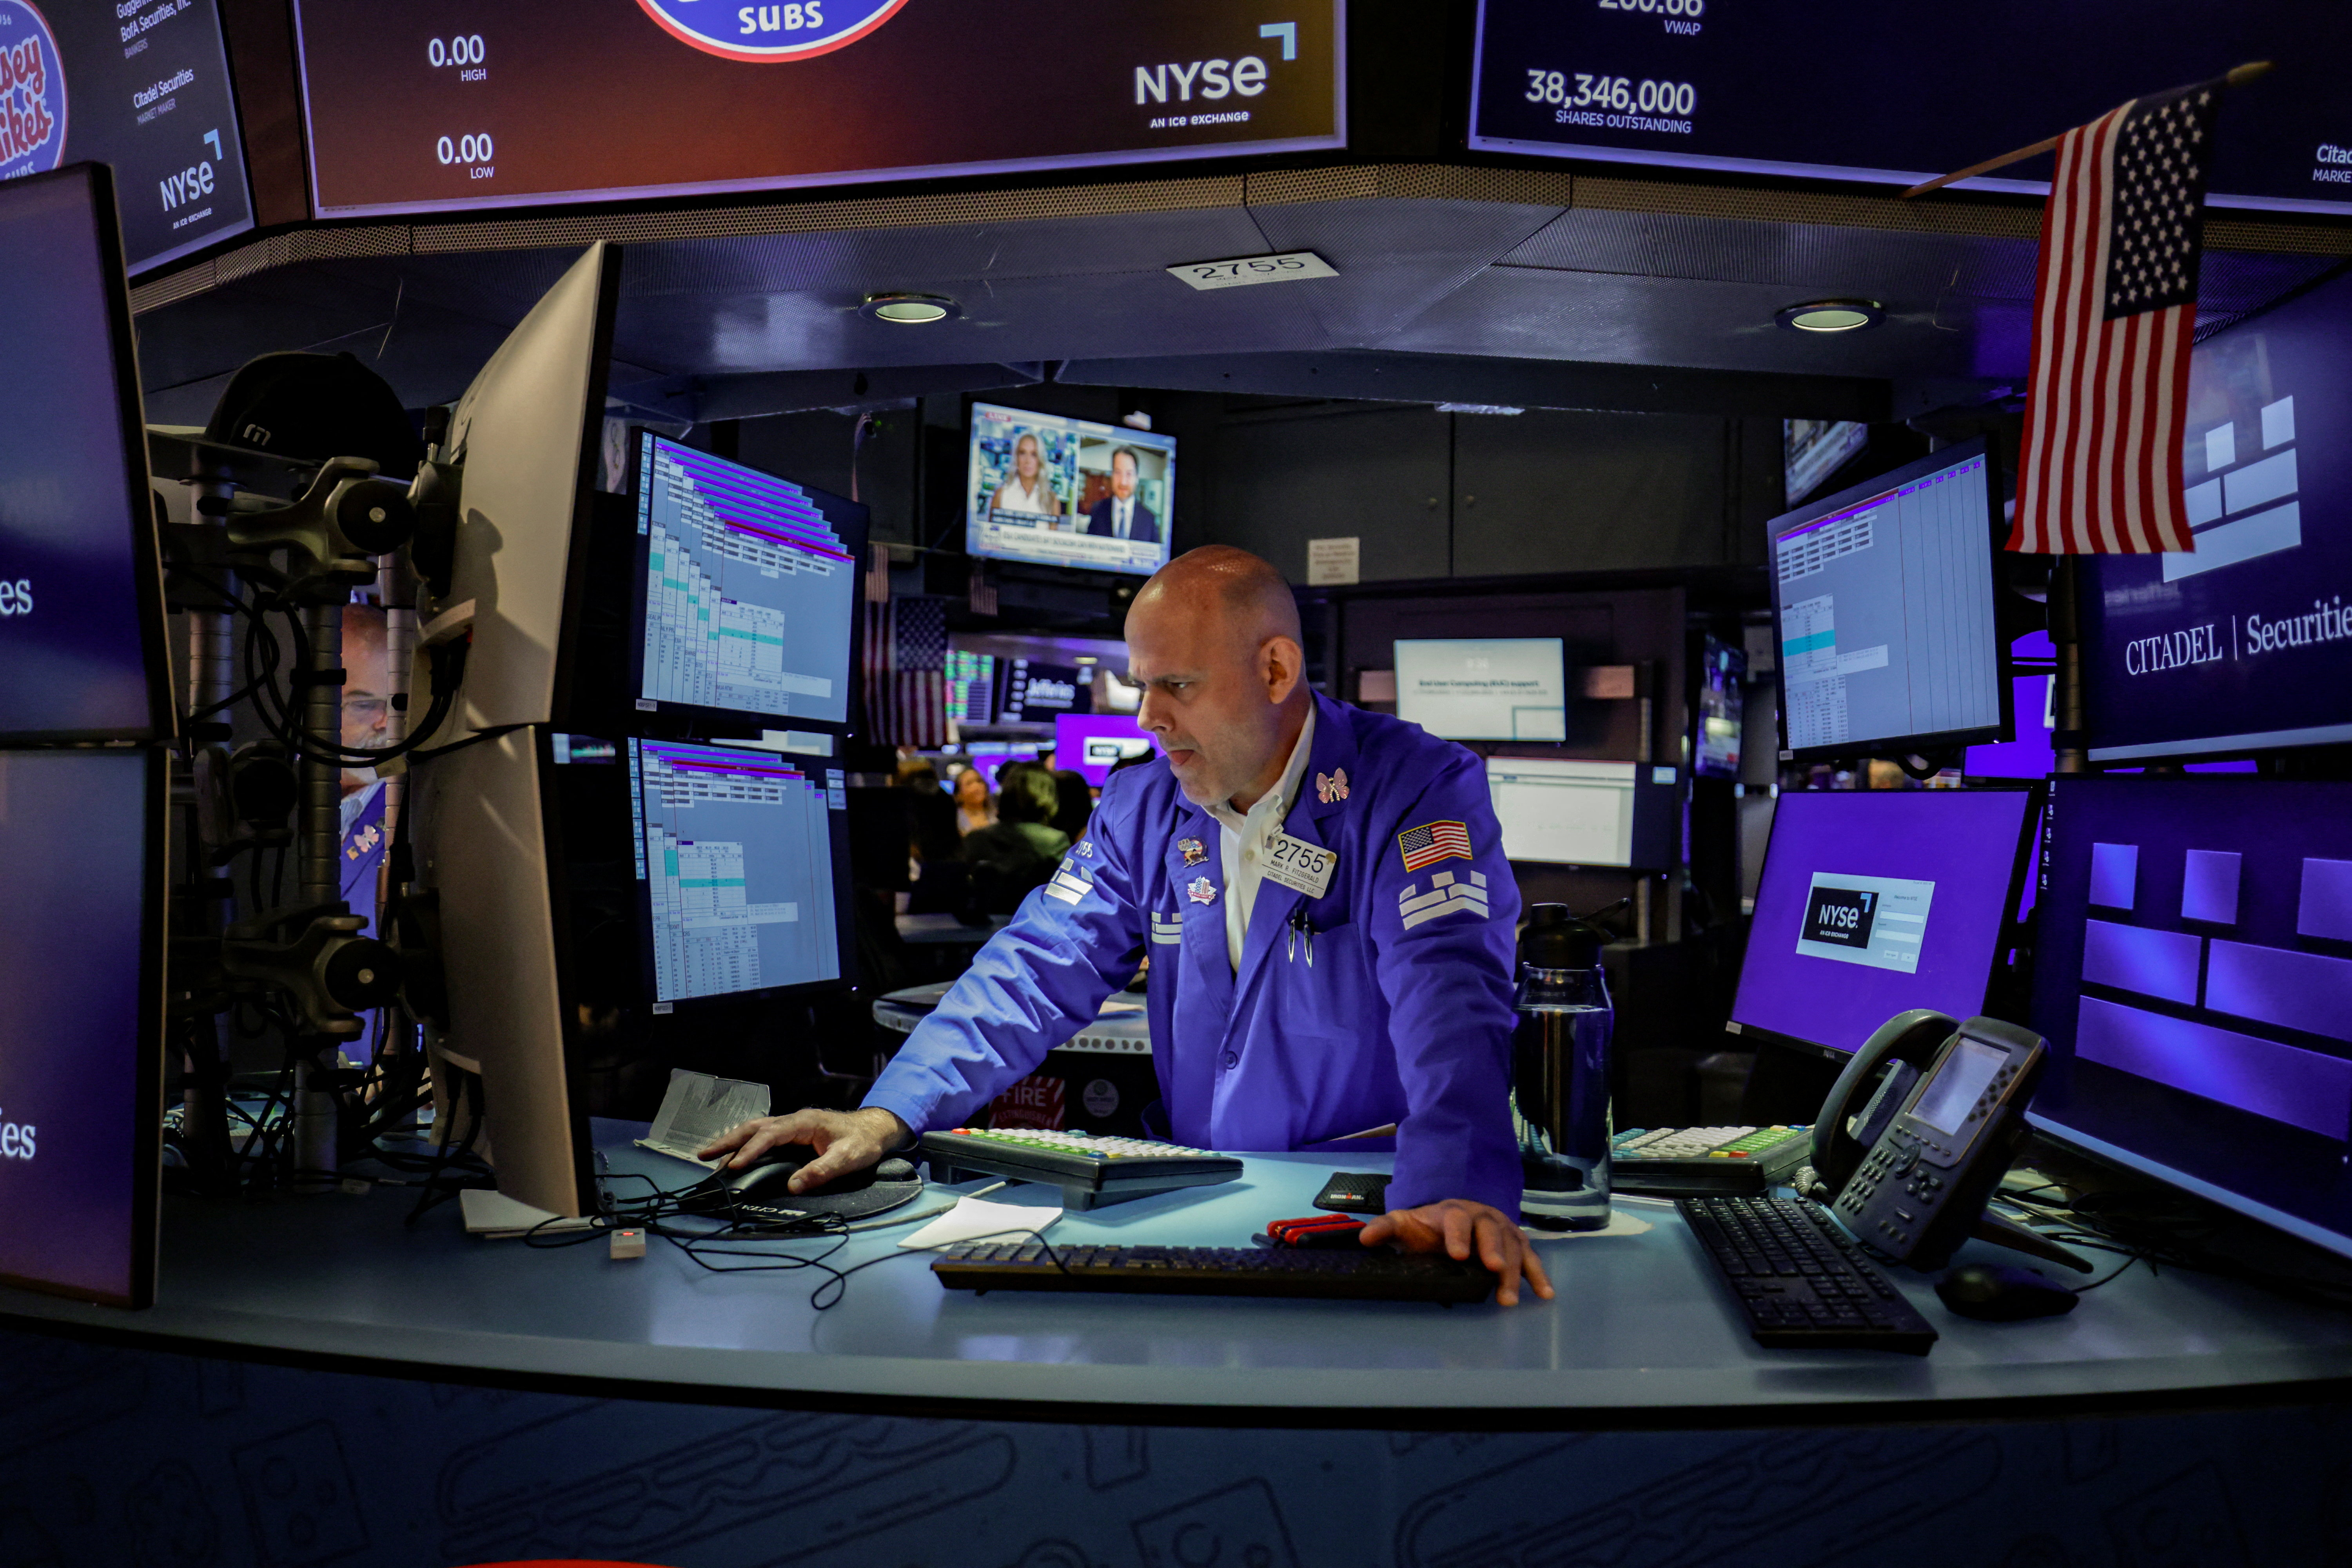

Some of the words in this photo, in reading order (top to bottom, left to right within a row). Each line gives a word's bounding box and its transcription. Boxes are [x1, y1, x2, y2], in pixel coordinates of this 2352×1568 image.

[120, 20, 140, 42] BofA
[139, 3, 176, 31] Securities,
[738, 1, 823, 34] SUBS
[1664, 20, 1700, 36] VWAP
[428, 34, 485, 67] 0.00
[461, 68, 486, 82] HIGH
[134, 83, 159, 109] Citadel
[158, 69, 194, 96] Securities
[1526, 69, 1694, 115] 38,346,000
[137, 107, 157, 126] MARKET
[158, 98, 176, 115] MAKER
[1151, 118, 1165, 128] AN
[1555, 110, 1604, 127] SHARES
[1607, 114, 1692, 134] OUTSTANDING
[437, 133, 493, 165] 0.00
[470, 166, 494, 179] LOW
[2313, 169, 2352, 183] MARKE
[173, 221, 180, 229] AN
[1192, 258, 1305, 279] 2755
[2126, 624, 2223, 675] CITADEL
[1273, 839, 1326, 873] 2755
[1267, 870, 1282, 881] CITADEL
[1284, 877, 1305, 890] SECURITIES
[1270, 859, 1283, 869] MARK
[1292, 868, 1319, 883] FITZGERALD
[0, 1107, 36, 1160] es
